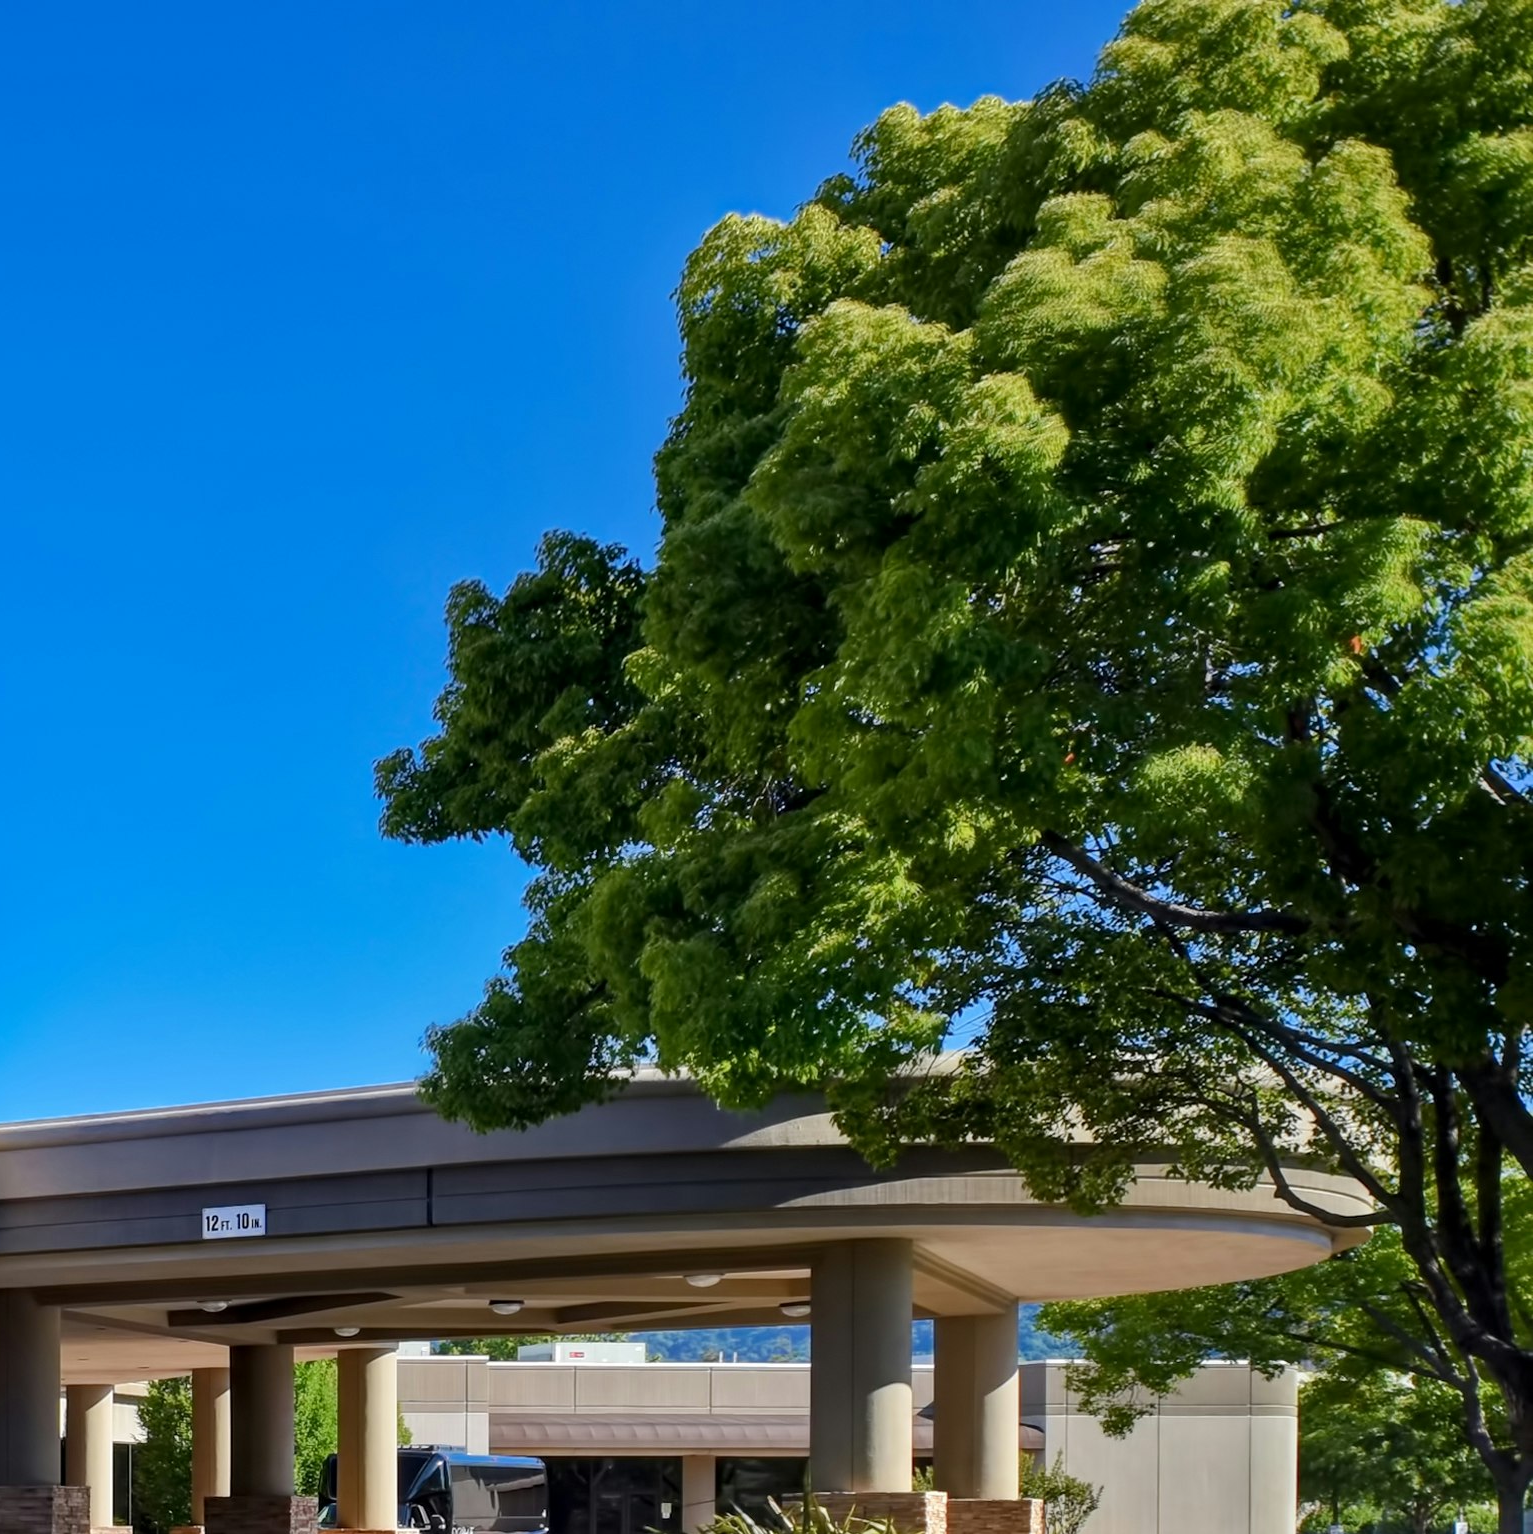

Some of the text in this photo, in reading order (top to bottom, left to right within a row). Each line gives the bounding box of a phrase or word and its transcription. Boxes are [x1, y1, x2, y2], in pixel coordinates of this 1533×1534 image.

[206, 1213, 262, 1232] 12 FT. 10 IN.
